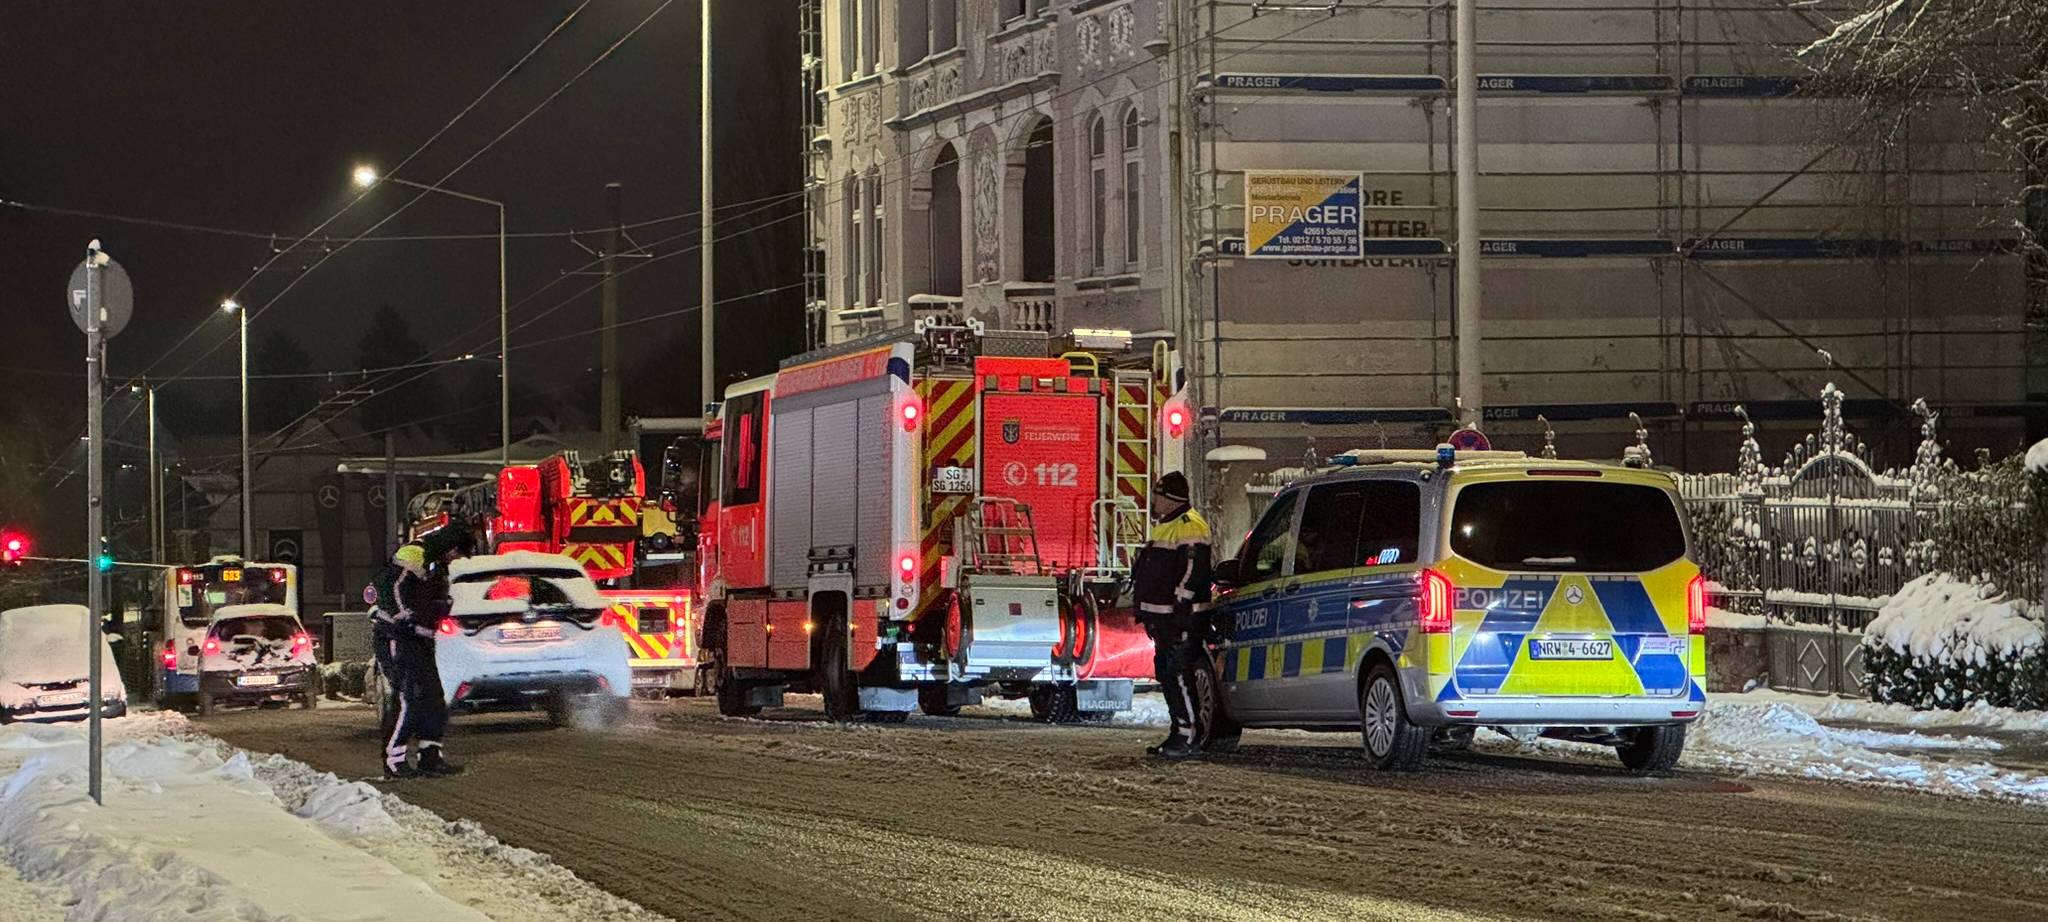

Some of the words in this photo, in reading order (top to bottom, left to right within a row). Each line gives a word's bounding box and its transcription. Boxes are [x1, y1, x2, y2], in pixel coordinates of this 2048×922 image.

[1227, 76, 1280, 88] PRAGER
[1477, 79, 1514, 89] AGER
[1694, 79, 1745, 88] PRAGER
[1297, 177, 1314, 185] UND
[1252, 205, 1357, 224] PRAGER
[1326, 227, 1357, 237] Solingen
[1279, 236, 1291, 244] Tel.
[1292, 236, 1310, 244] 0212
[1322, 236, 1332, 244] 70
[1480, 241, 1517, 252] AGER
[1233, 411, 1286, 422] PRAGER
[1485, 408, 1519, 419] AGER
[946, 469, 960, 480] SG
[1033, 463, 1078, 486] 112
[934, 480, 946, 491] SG
[949, 480, 972, 491] 1256
[1455, 590, 1544, 610] POLIZEI
[1235, 608, 1269, 632] POLIZEI
[1539, 642, 1562, 656] NRW
[1568, 642, 1611, 656] 4-6627
[1081, 700, 1128, 710] MAGIRUS
